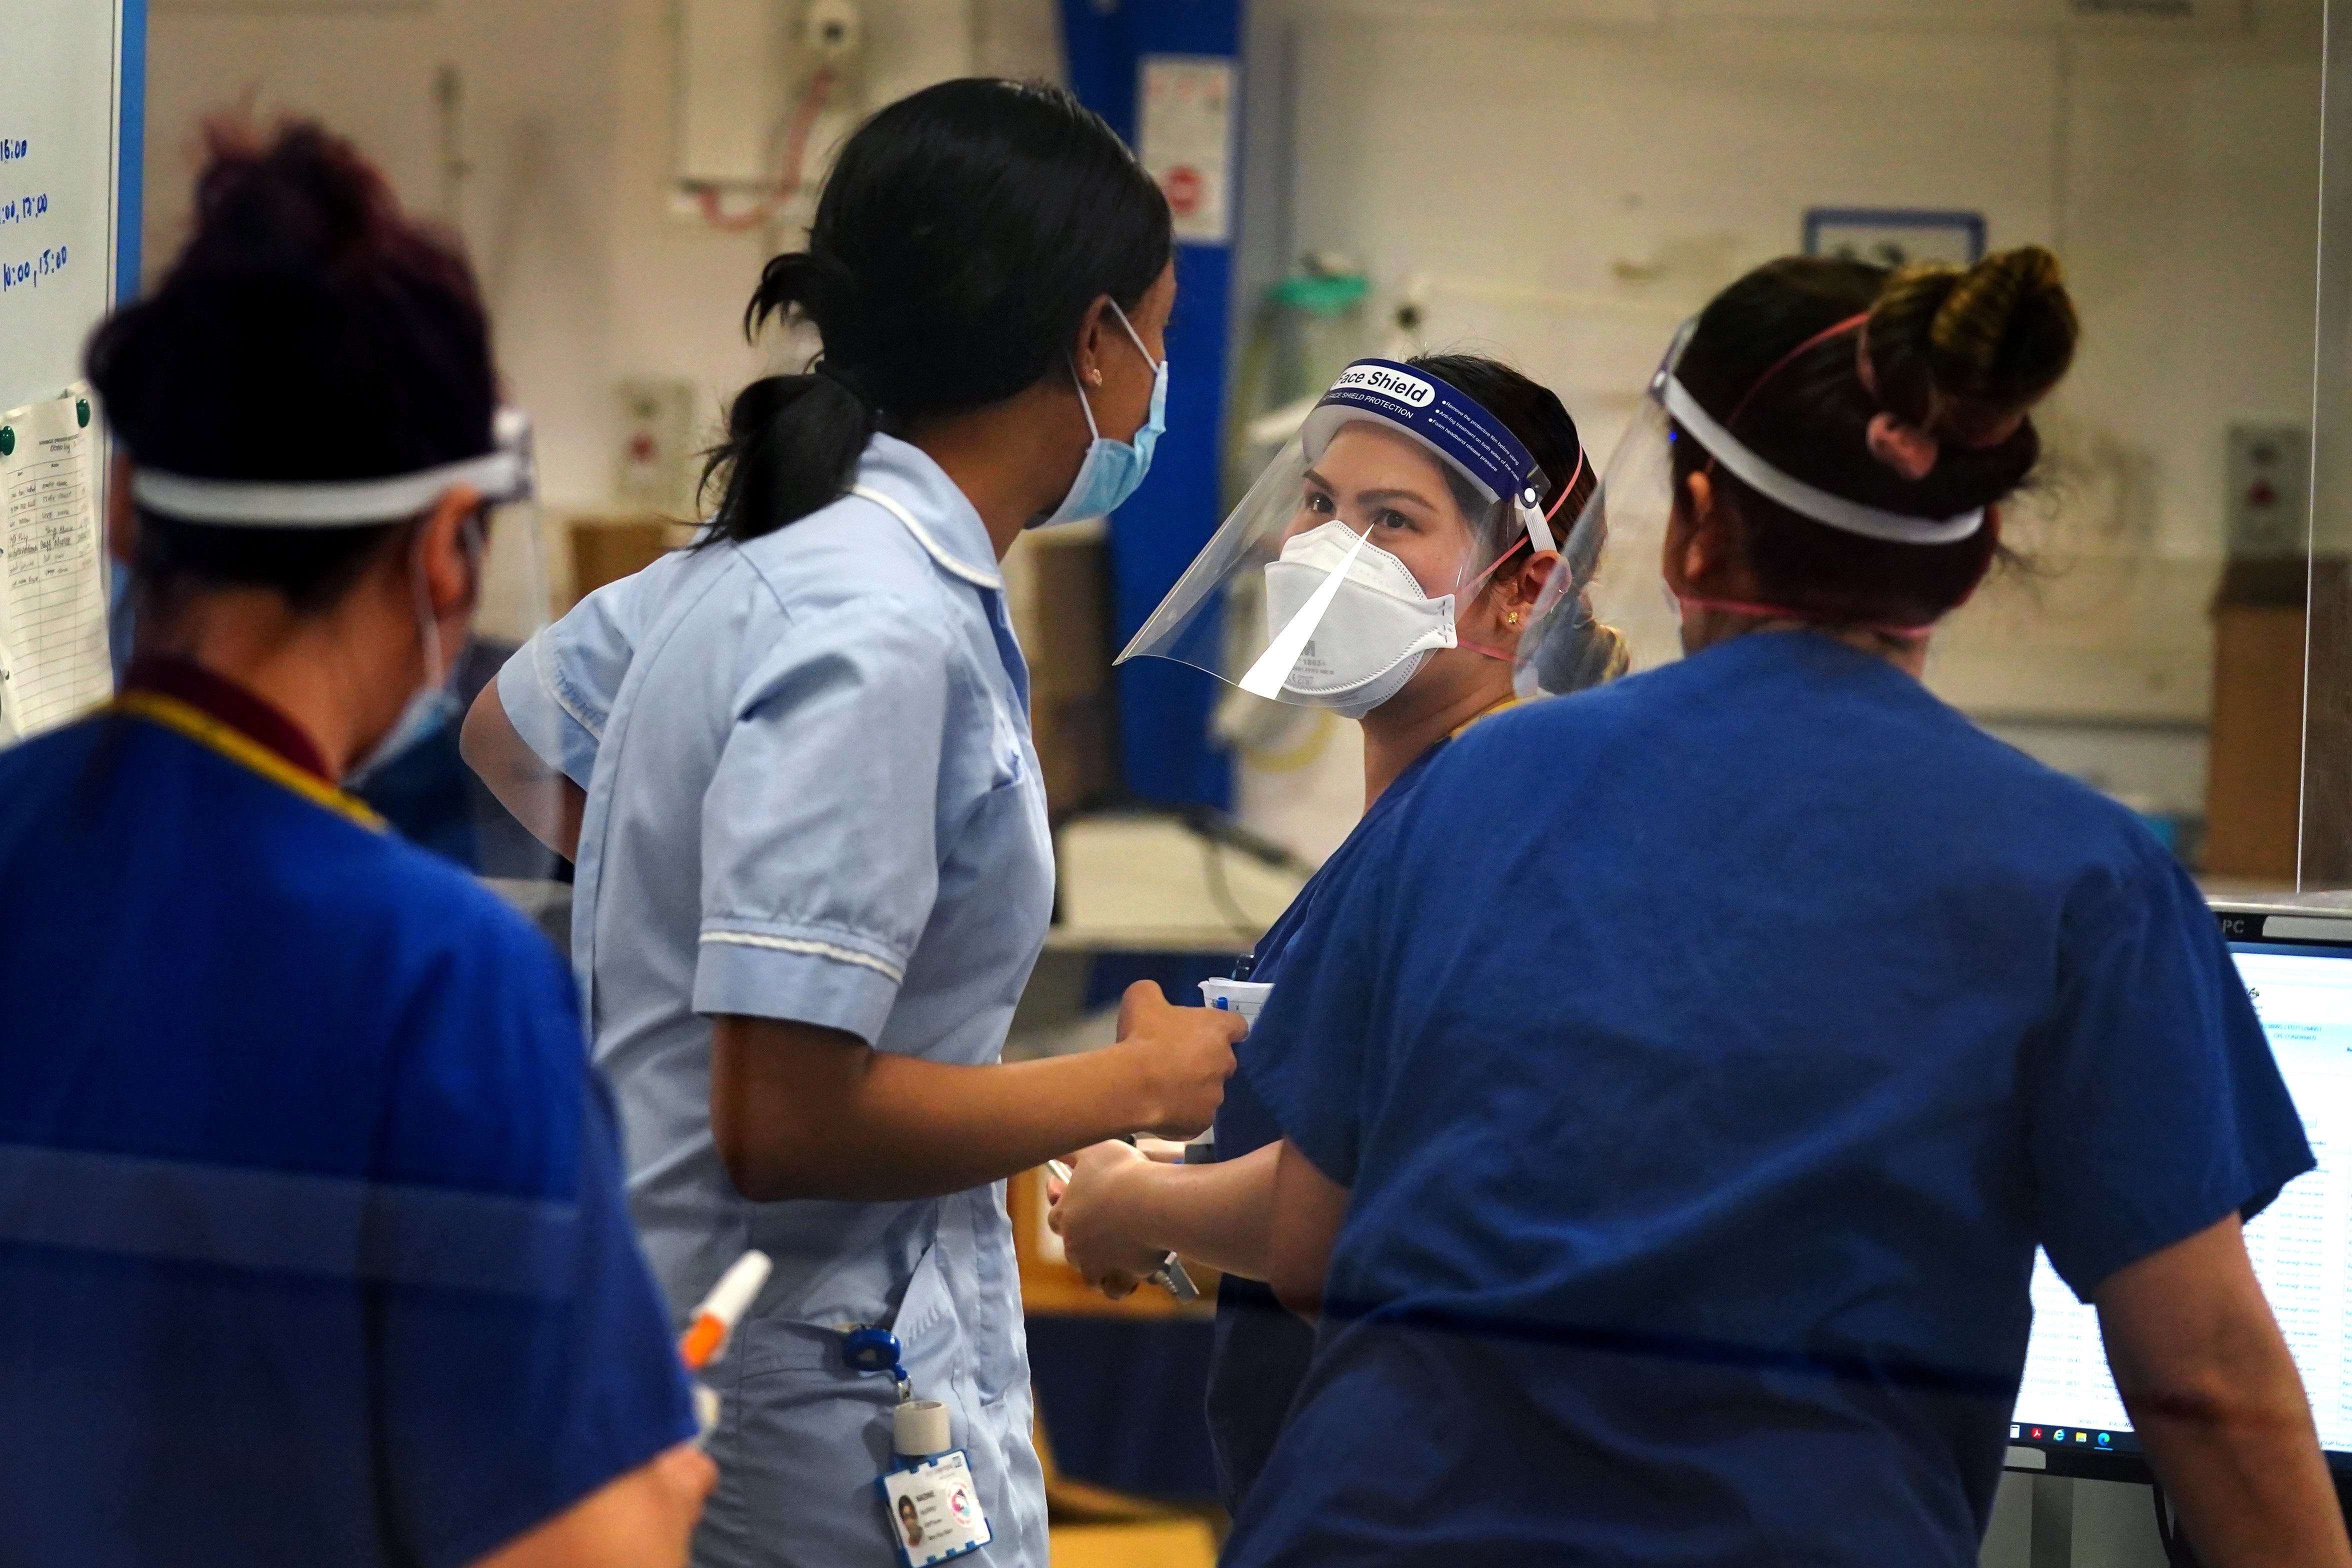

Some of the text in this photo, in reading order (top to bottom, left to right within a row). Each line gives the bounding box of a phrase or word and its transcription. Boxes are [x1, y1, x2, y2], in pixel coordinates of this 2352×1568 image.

[1334, 371, 1428, 402] Face Shield
[1342, 392, 1365, 400] SHIELD
[1364, 396, 1414, 419] PROTECTION
[1432, 419, 1498, 472] Foam headband release pressure
[1446, 402, 1464, 416] Remove
[1470, 420, 1490, 437] protective
[1490, 435, 1498, 444] film
[1498, 442, 1510, 455] before
[1510, 454, 1519, 466] using
[1456, 422, 1476, 439] treatment
[1481, 442, 1490, 452] both
[1490, 450, 1501, 461] sides
[2222, 919, 2244, 934] PC
